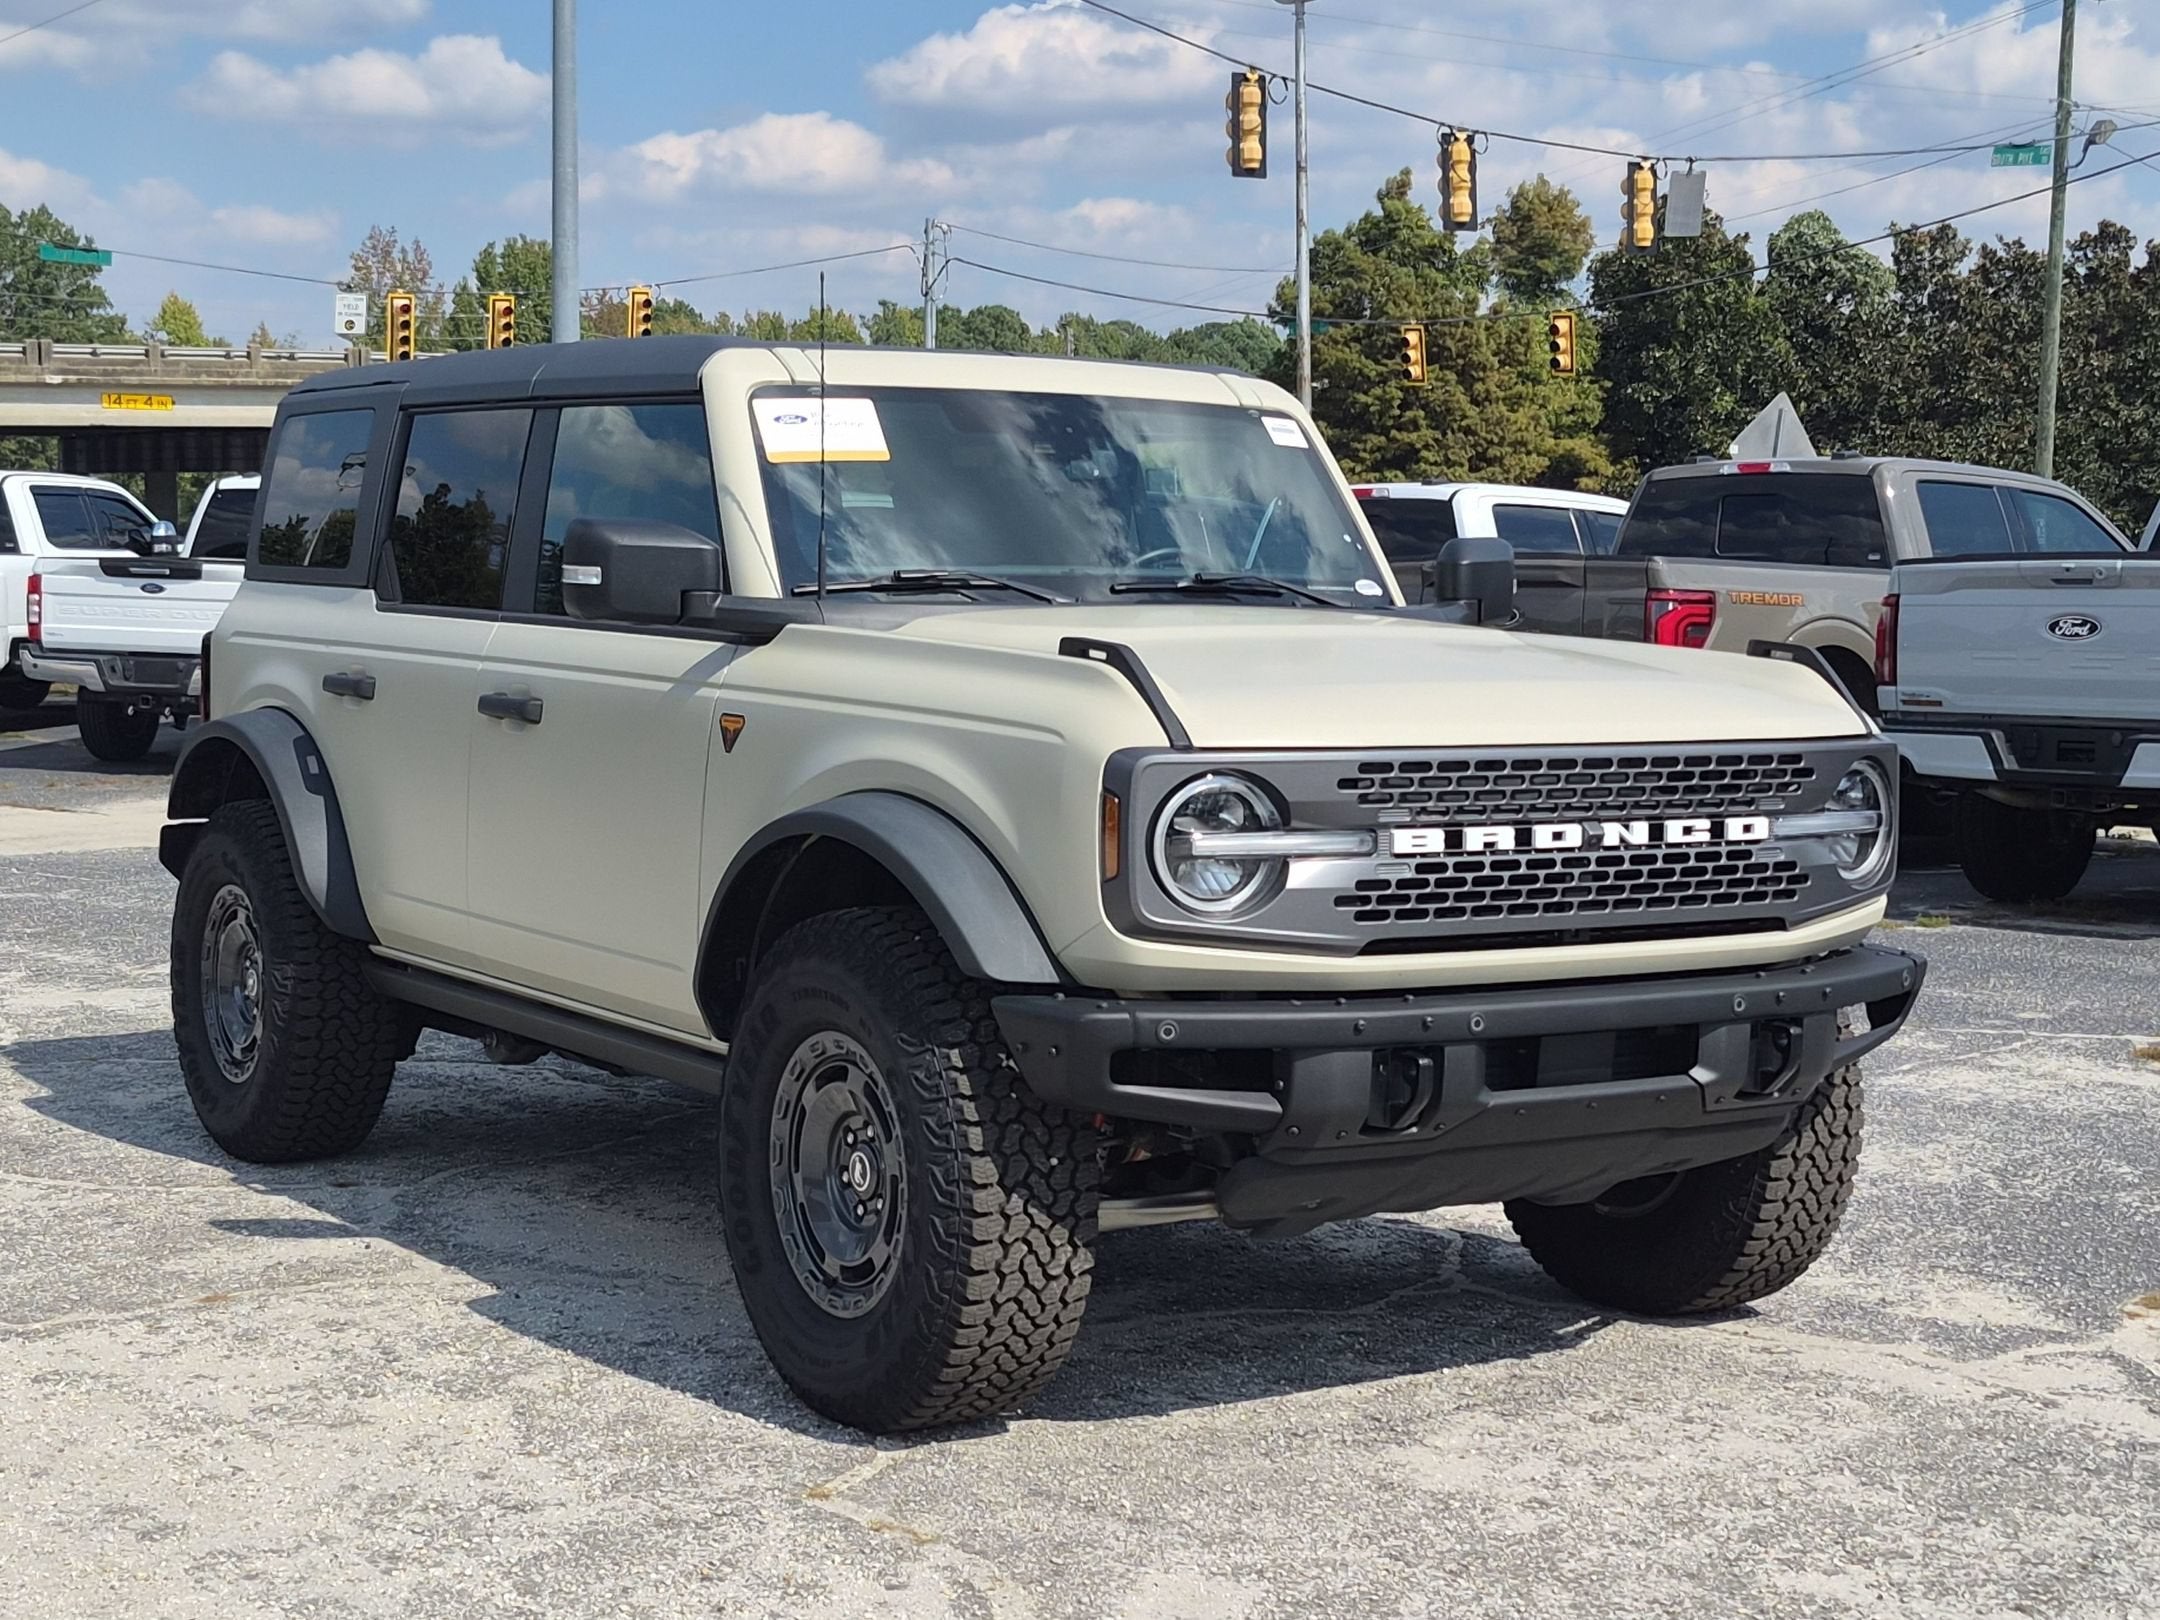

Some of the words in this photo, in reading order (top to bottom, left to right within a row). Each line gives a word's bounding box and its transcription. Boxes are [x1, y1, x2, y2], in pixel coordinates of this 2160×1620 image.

[107, 393, 122, 409] 14
[143, 394, 153, 408] 4
[1728, 591, 1804, 606] TREMOR
[58, 604, 161, 619] SUPER
[2053, 618, 2093, 636] Ford
[1391, 816, 1770, 854] BRONCO
